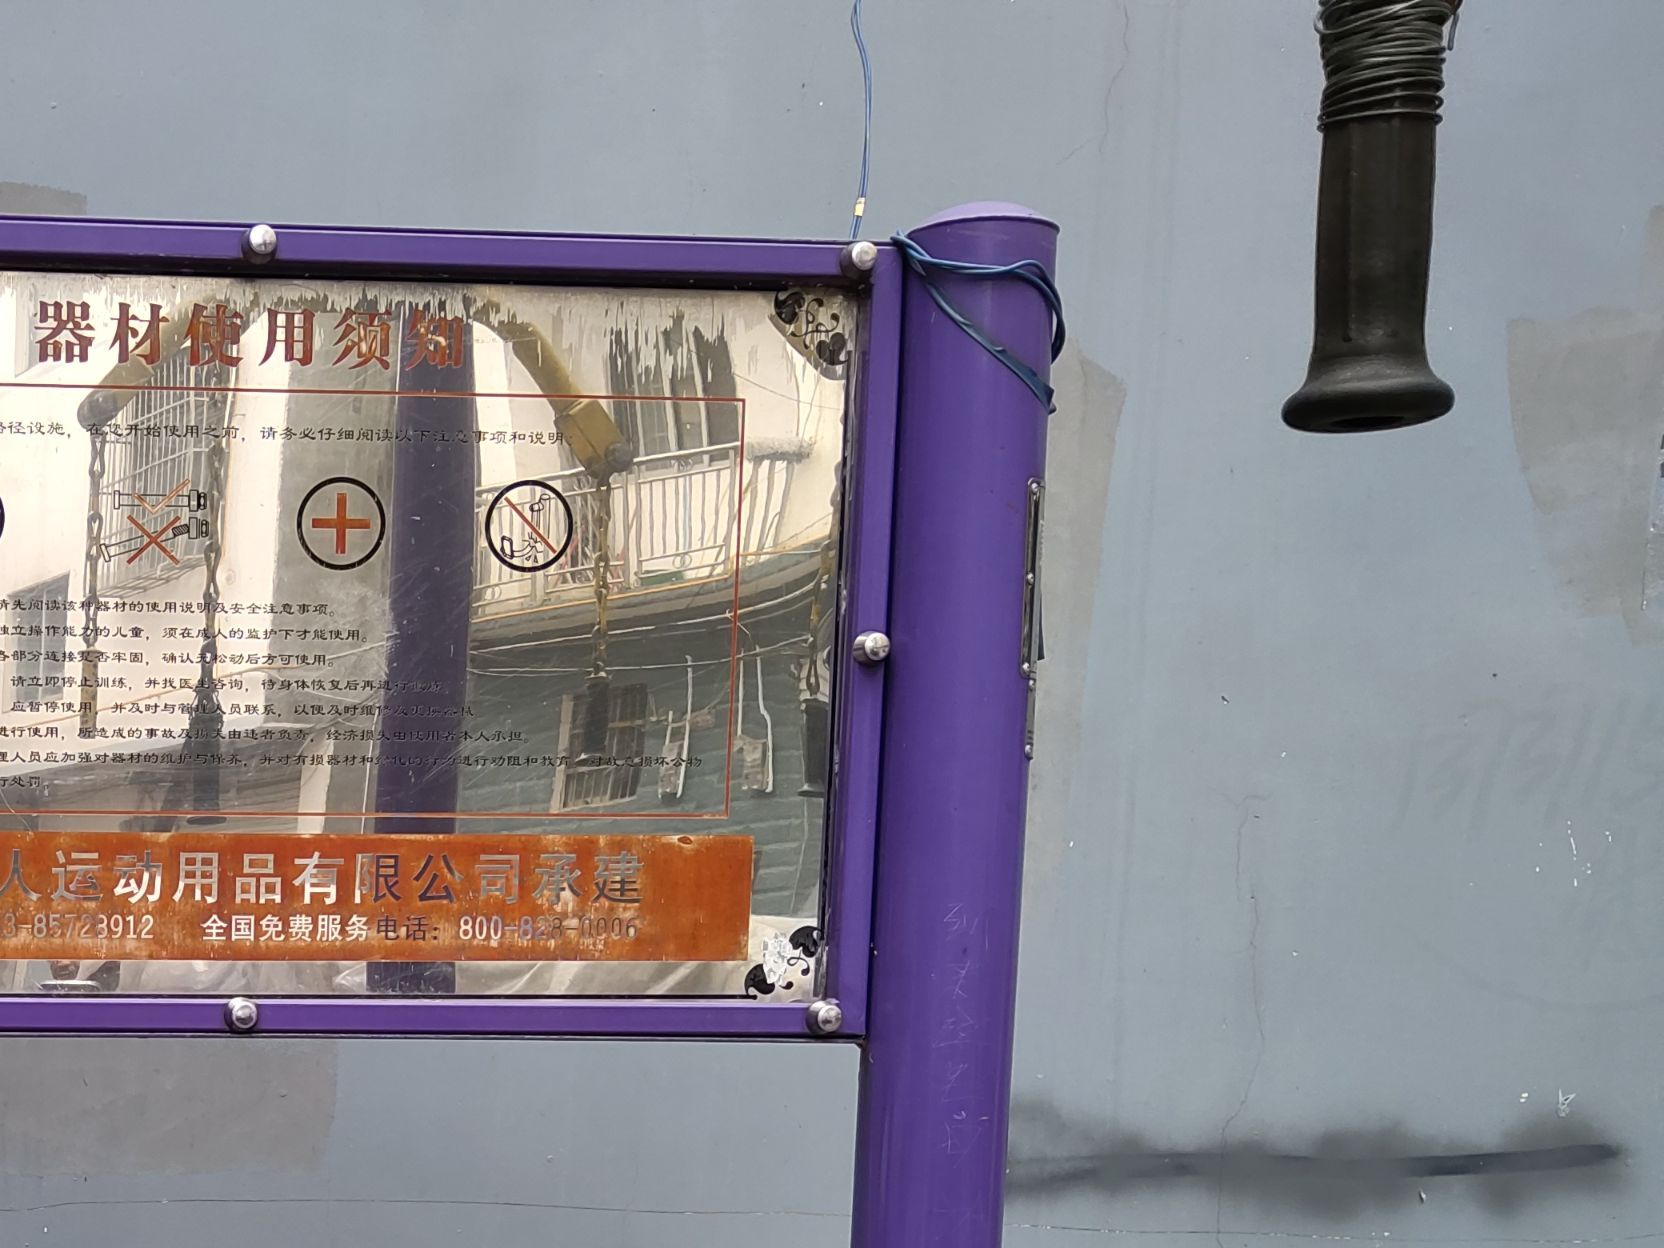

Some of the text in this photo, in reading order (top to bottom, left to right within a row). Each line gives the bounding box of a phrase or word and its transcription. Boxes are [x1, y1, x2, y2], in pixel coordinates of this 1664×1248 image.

[34, 300, 463, 370] 器材使用须知
